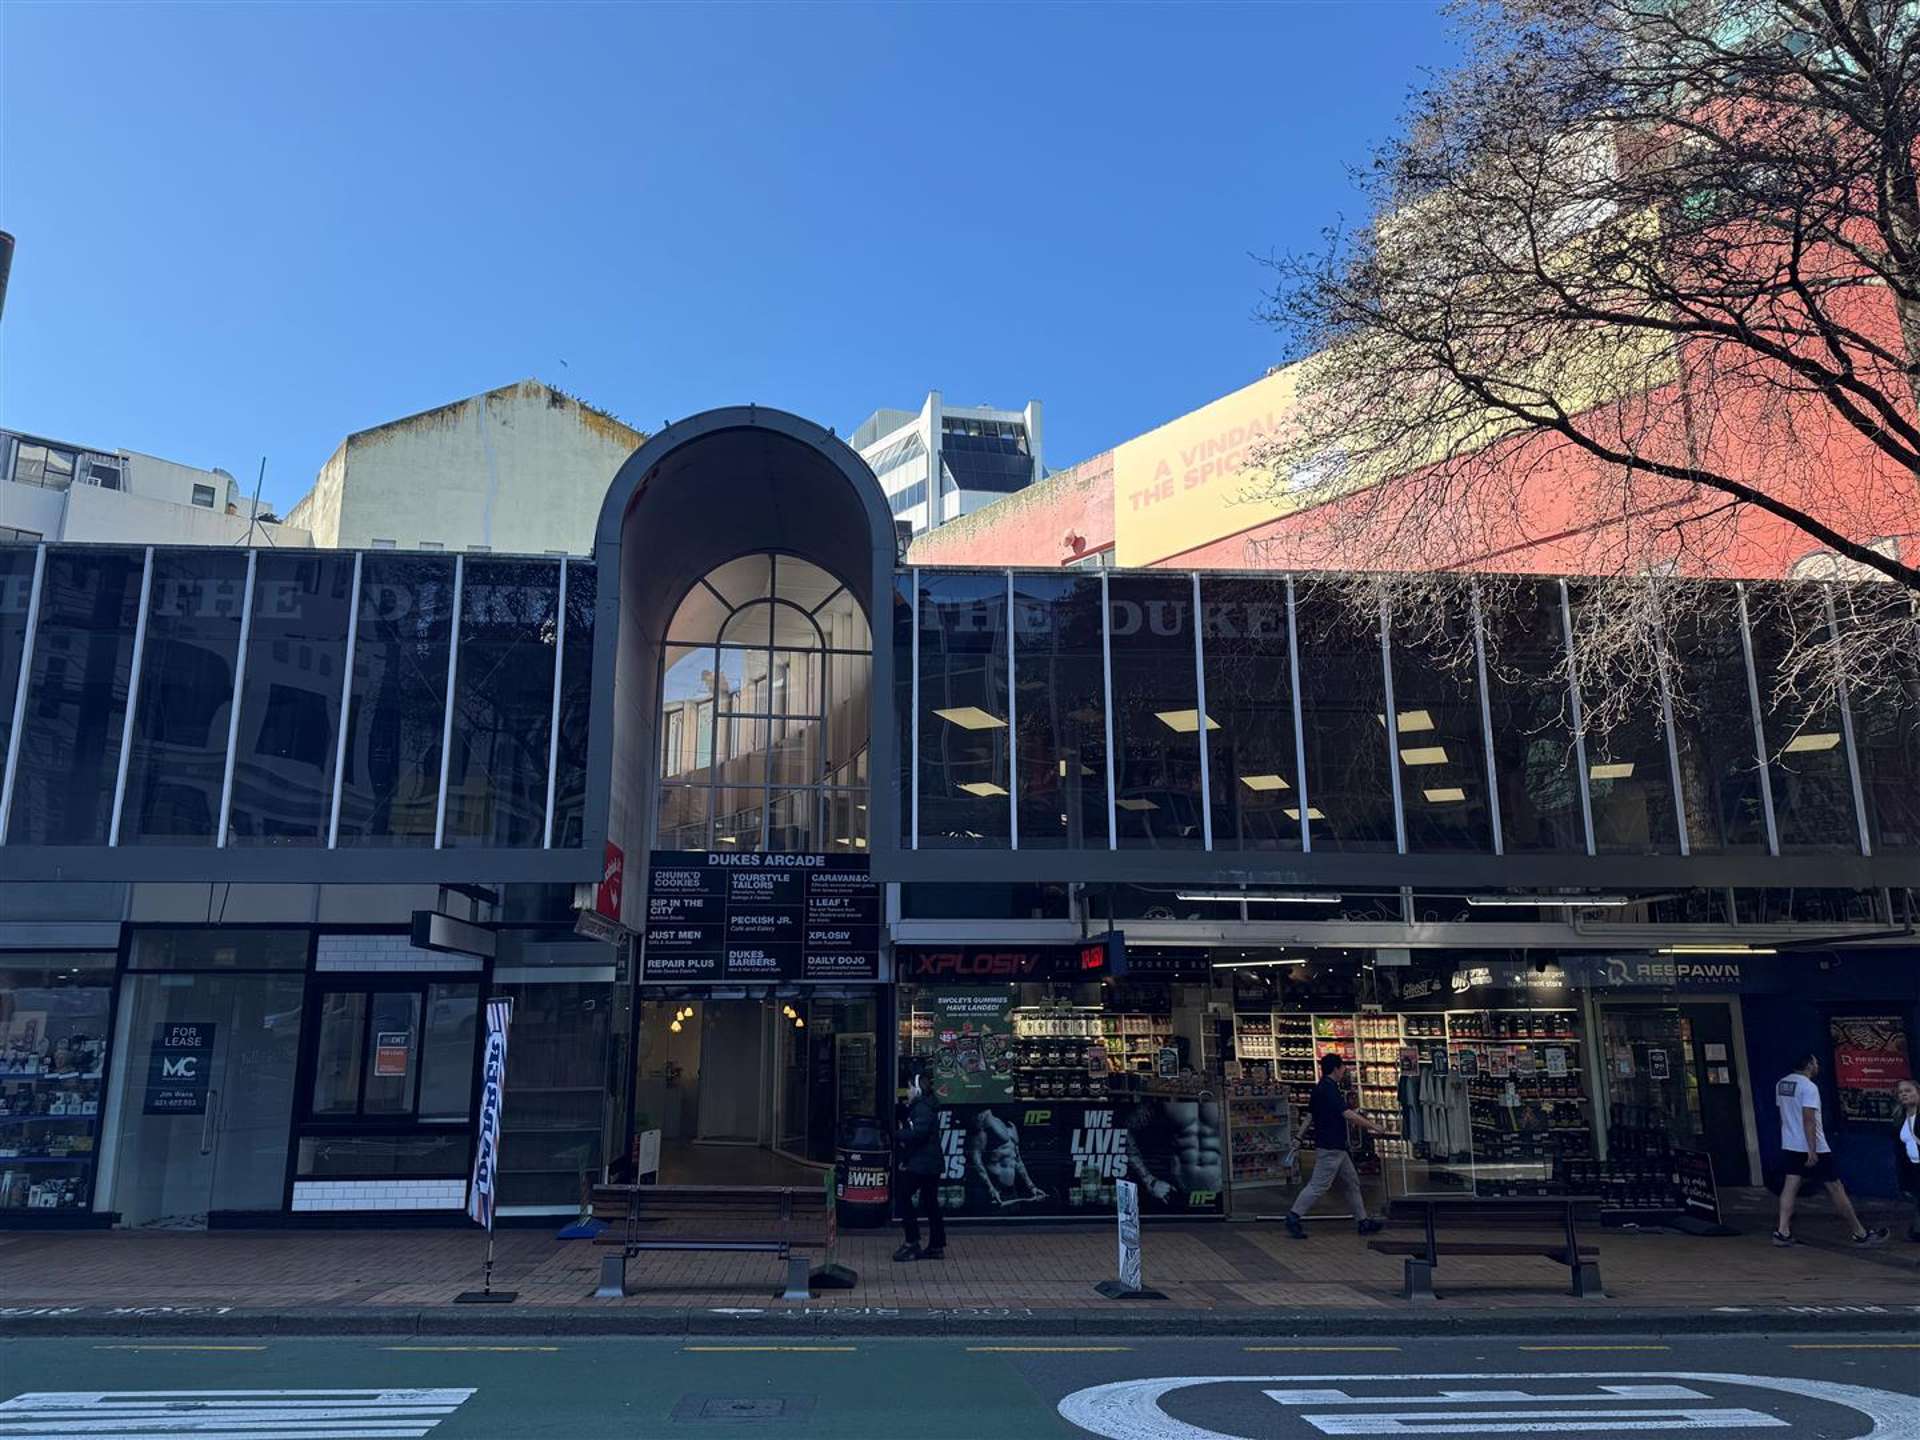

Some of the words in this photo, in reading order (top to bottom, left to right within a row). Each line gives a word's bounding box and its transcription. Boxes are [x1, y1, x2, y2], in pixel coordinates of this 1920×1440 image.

[1154, 458, 1172, 481] A
[1129, 477, 1175, 511] THE
[708, 853, 761, 866] DUKES
[764, 854, 826, 867] ARCADE
[732, 873, 791, 882] YOURSTYLE
[654, 879, 700, 887] COOKIES
[731, 881, 774, 889] TAILORS
[650, 899, 668, 908] SIP
[670, 899, 681, 907] IN
[683, 899, 704, 908] THE
[650, 906, 674, 915] CITY
[731, 915, 775, 924] PECKISH
[648, 930, 676, 940] JUST
[678, 931, 702, 940] MEN
[808, 931, 851, 940] XPLOSIV
[728, 950, 764, 958] DUKES
[647, 959, 686, 968] REPAIR
[687, 959, 715, 968] PLUS
[728, 958, 777, 966] BARBERS
[807, 956, 837, 965] DAILY
[838, 956, 865, 965] DOJO
[915, 951, 1041, 976] XPLOSIV
[1636, 964, 1740, 977] RESPAWN
[172, 1027, 198, 1037] FOR
[164, 1036, 203, 1047] LEASE
[162, 1056, 198, 1077] MC
[1083, 1109, 1115, 1129] WE
[1070, 1128, 1129, 1155] LIVE
[1072, 1154, 1130, 1179] THIS
